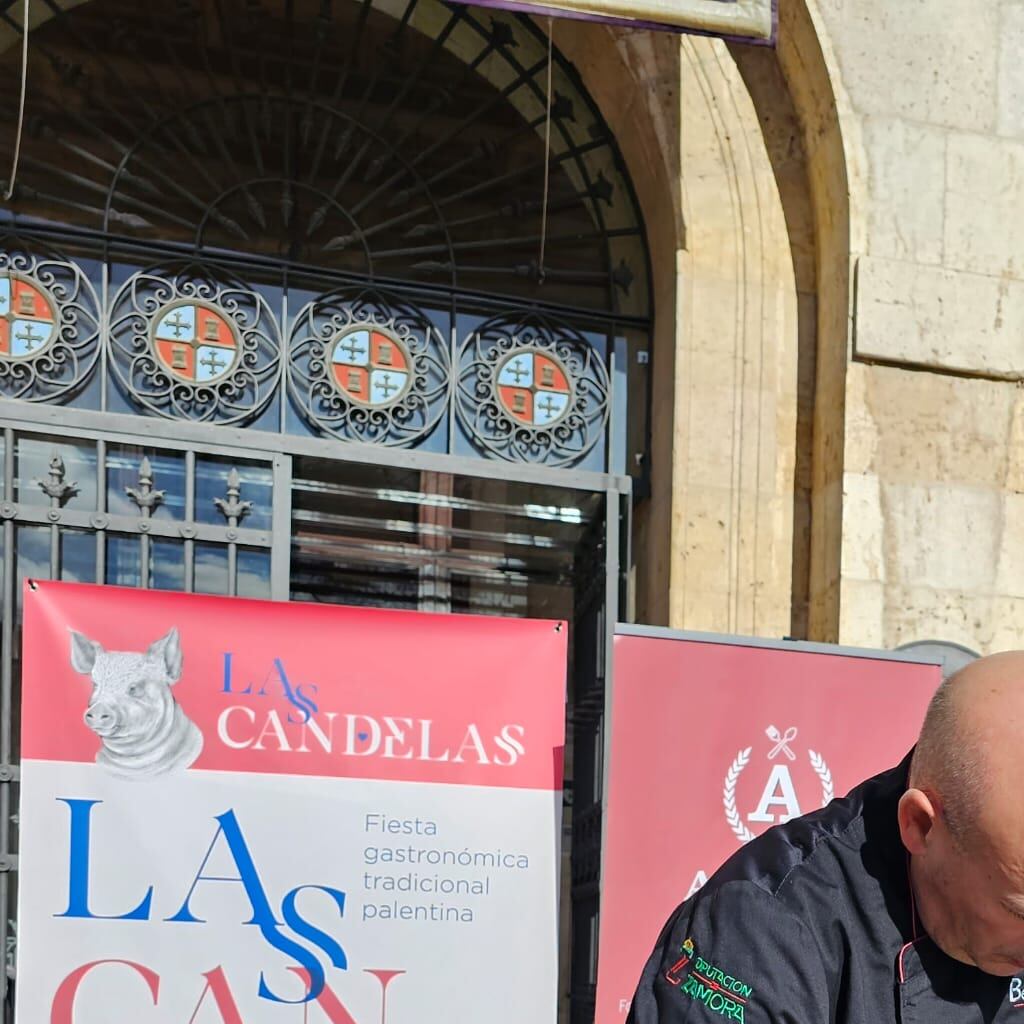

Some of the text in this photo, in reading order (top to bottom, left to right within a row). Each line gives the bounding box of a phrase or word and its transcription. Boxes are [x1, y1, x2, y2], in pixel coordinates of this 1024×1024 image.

[220, 652, 318, 724] LAS
[217, 705, 525, 766] CANDELAS
[365, 814, 437, 835] Fiesta
[364, 845, 529, 869] gastronómica
[363, 872, 489, 895] tradicional
[52, 797, 348, 1003] LAS
[362, 901, 473, 922] palentina
